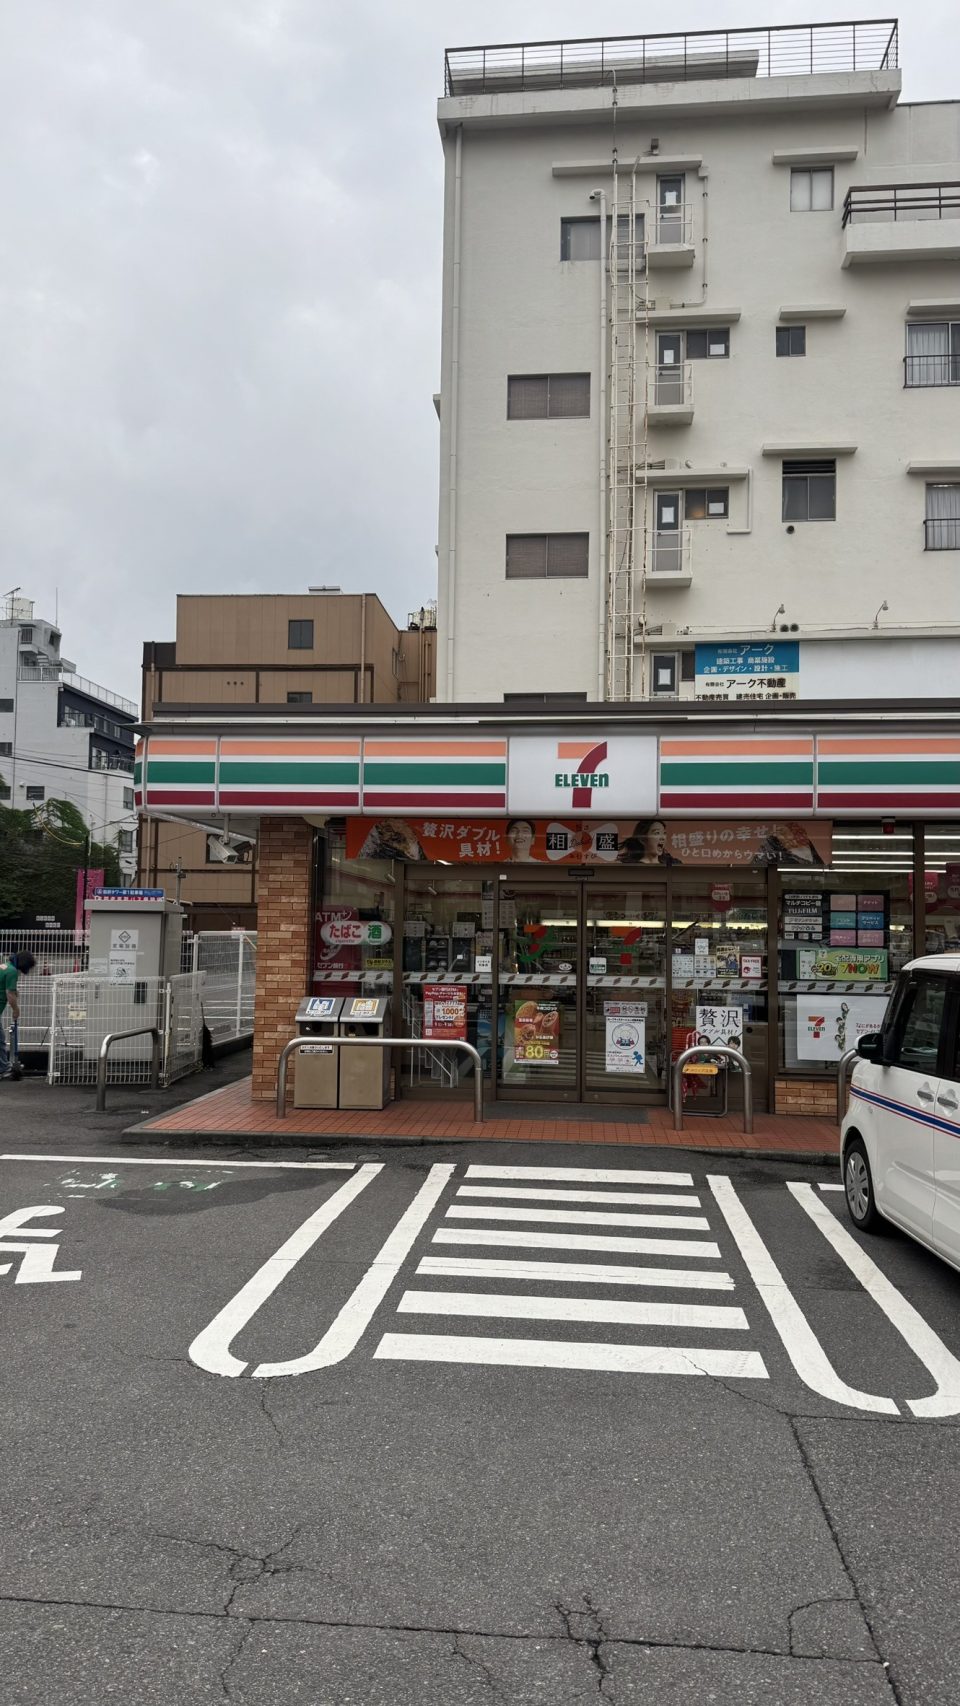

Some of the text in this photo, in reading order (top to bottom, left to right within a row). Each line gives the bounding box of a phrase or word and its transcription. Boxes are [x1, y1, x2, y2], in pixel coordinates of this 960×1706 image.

[740, 644, 774, 655] アーク
[726, 677, 786, 689] アーク不動産
[422, 821, 500, 841] 贅沢ダブル
[329, 923, 382, 939] たばこ 酒
[699, 1008, 740, 1028] 贅沢
